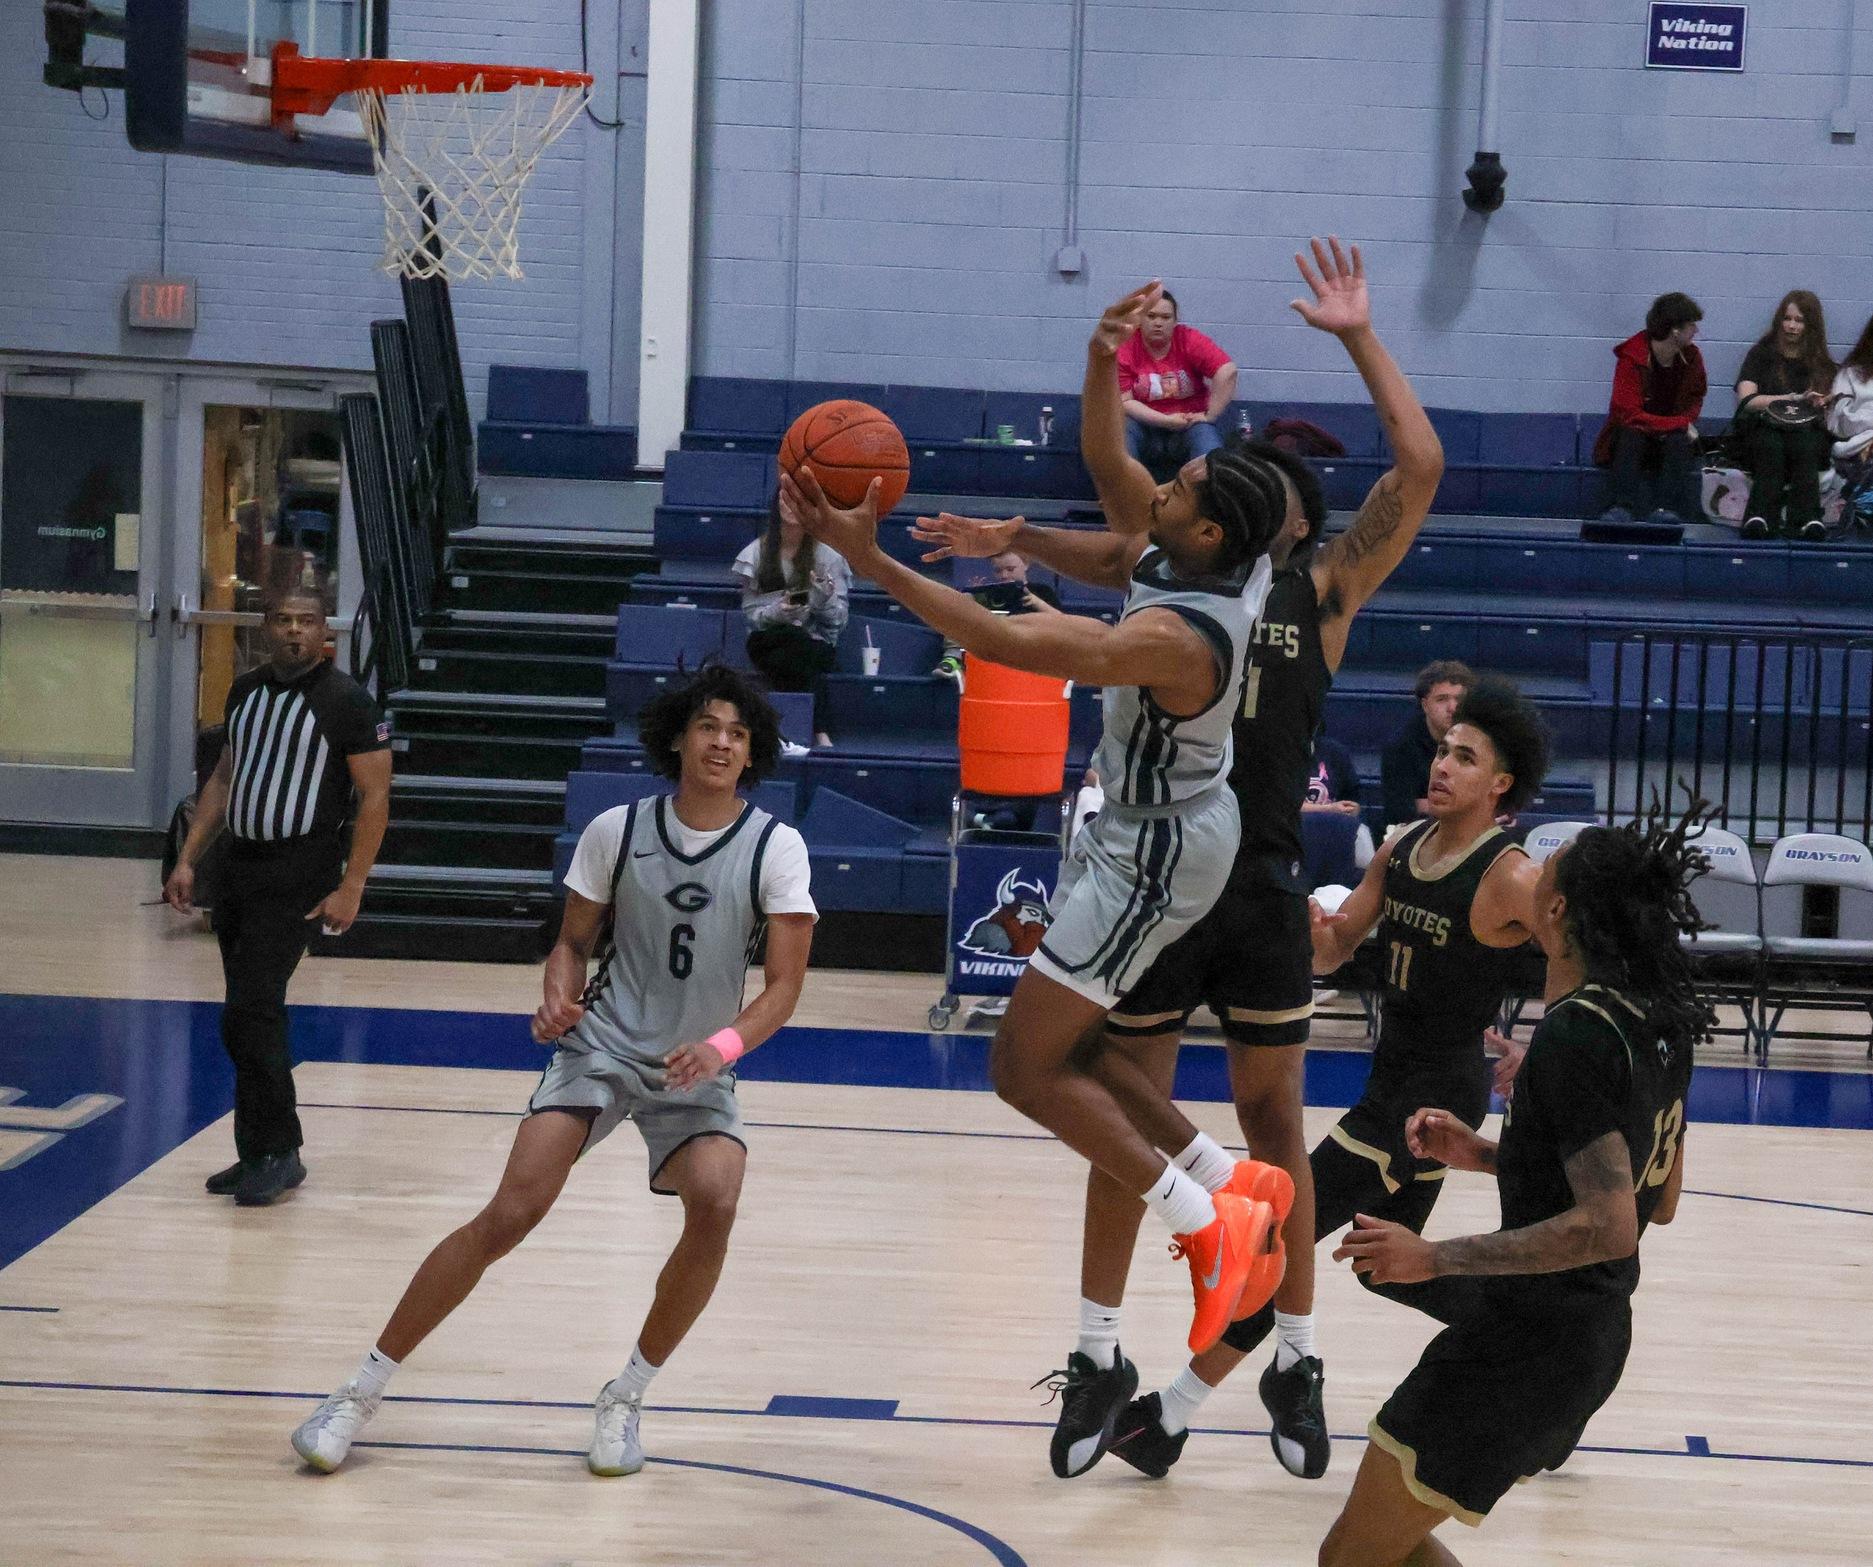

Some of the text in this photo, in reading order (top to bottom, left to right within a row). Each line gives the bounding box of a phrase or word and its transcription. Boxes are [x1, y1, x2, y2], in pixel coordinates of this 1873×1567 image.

[1658, 35, 1734, 51] Nation
[1661, 18, 1733, 36] Viking
[1252, 622, 1300, 659] TES
[1785, 848, 1862, 863] GRAYSON
[1384, 896, 1452, 947] OYOTES
[668, 922, 696, 980] 6
[960, 961, 1027, 977] VIKIN
[1388, 940, 1413, 991] 11
[1635, 1097, 1684, 1193] 13
